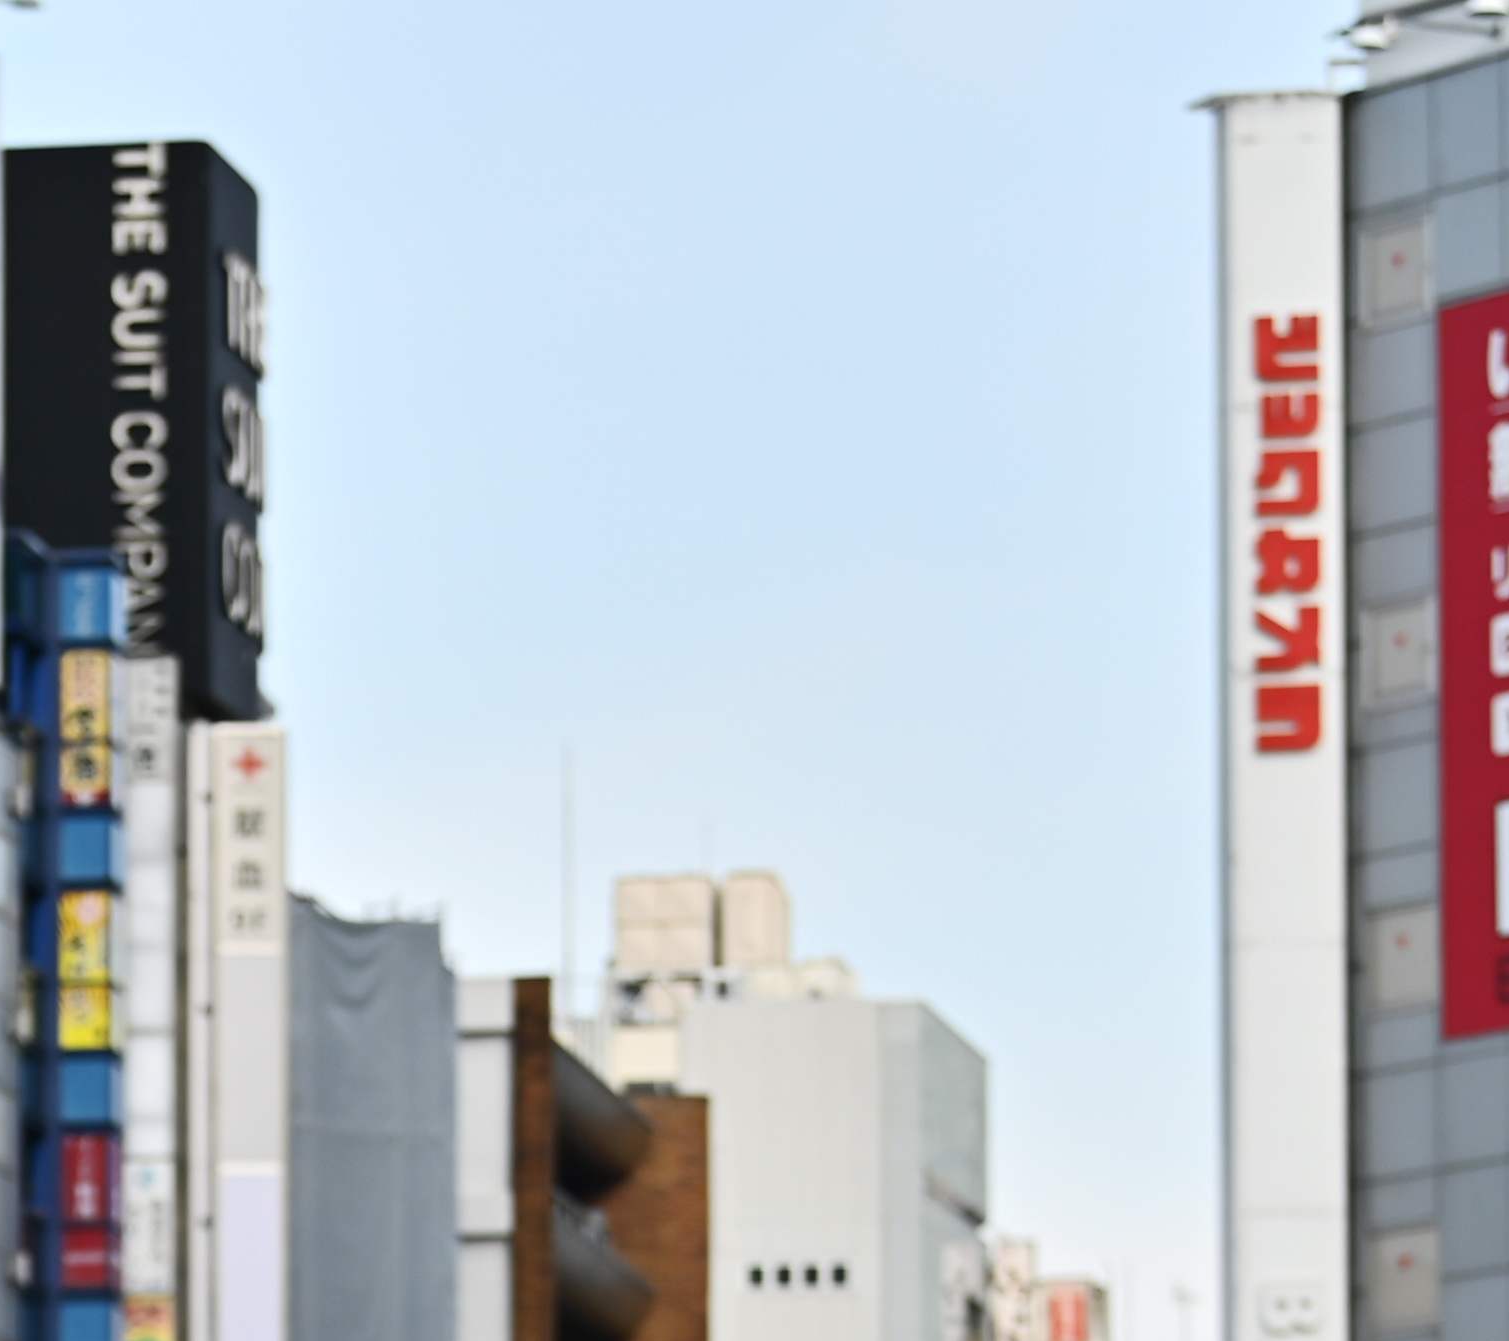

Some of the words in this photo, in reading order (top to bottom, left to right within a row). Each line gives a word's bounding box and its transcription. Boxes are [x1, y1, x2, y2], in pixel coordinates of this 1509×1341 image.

[112, 142, 168, 254] THE
[110, 270, 166, 398] SUIT
[110, 410, 168, 657] COMPAN
